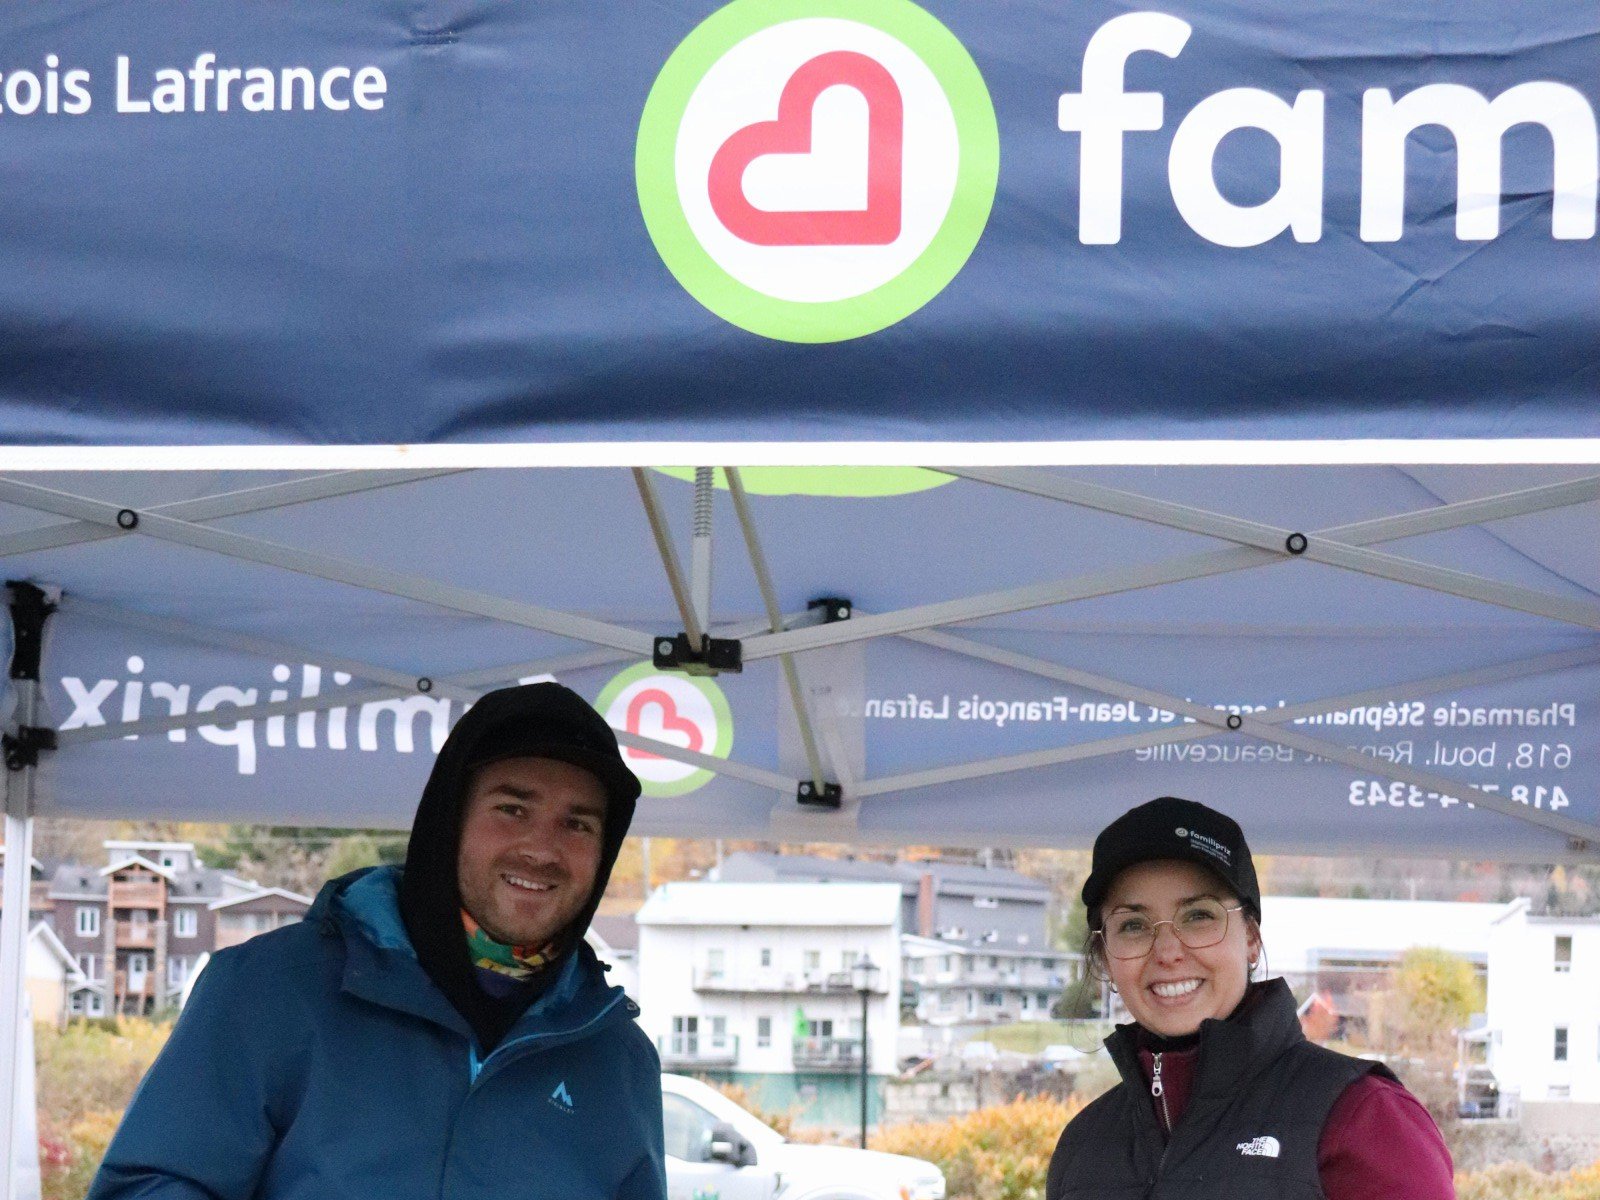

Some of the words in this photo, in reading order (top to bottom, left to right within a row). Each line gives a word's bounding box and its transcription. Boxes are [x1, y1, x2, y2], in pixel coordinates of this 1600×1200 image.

[0, 55, 92, 114] ois
[116, 53, 388, 114] Lafrance
[1058, 11, 1598, 248] fam
